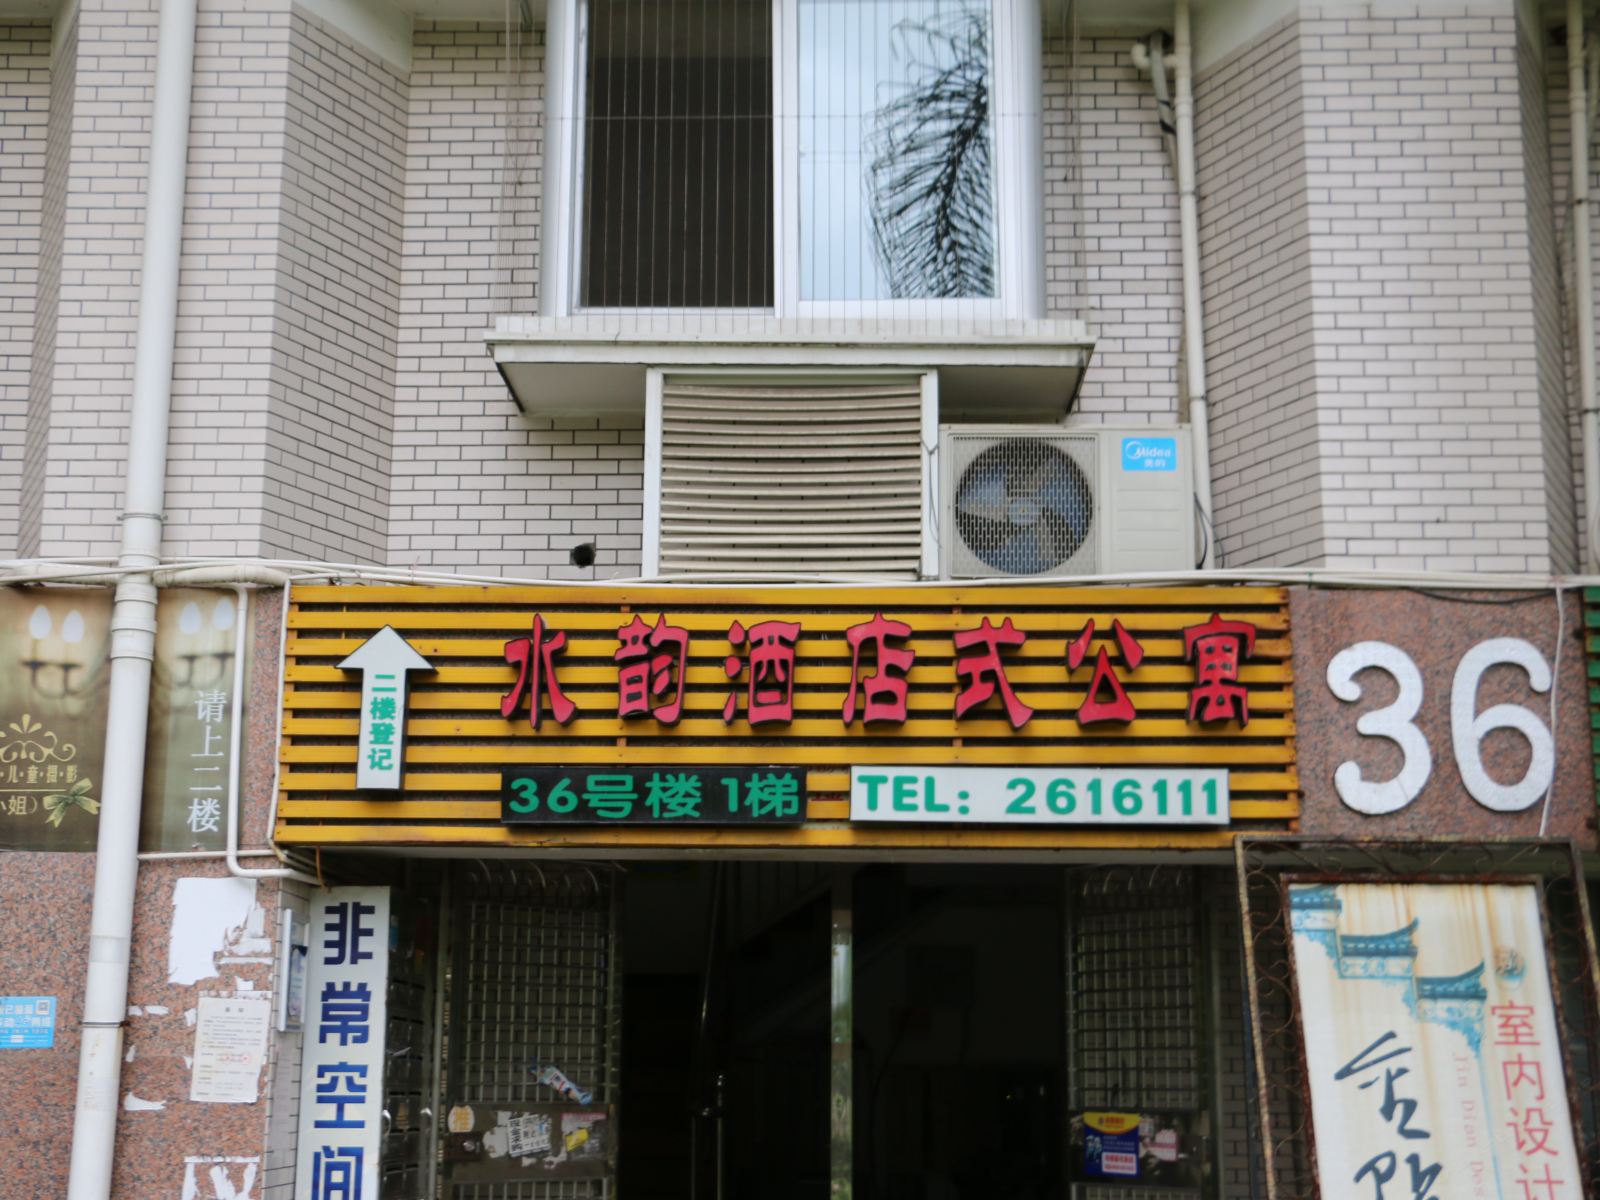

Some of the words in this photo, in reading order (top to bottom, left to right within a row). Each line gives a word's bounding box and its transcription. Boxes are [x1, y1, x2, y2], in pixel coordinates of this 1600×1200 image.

[367, 674, 397, 770] 二楼登记
[501, 611, 1257, 730] 水韵酒店式公寓
[1327, 637, 1555, 814] 36
[187, 689, 228, 832] 请上二楼
[857, 774, 970, 815] TEL:
[1005, 777, 1218, 816] 2616111
[311, 901, 376, 1200] 非常空间
[1490, 1000, 1565, 1200] 室内设计
